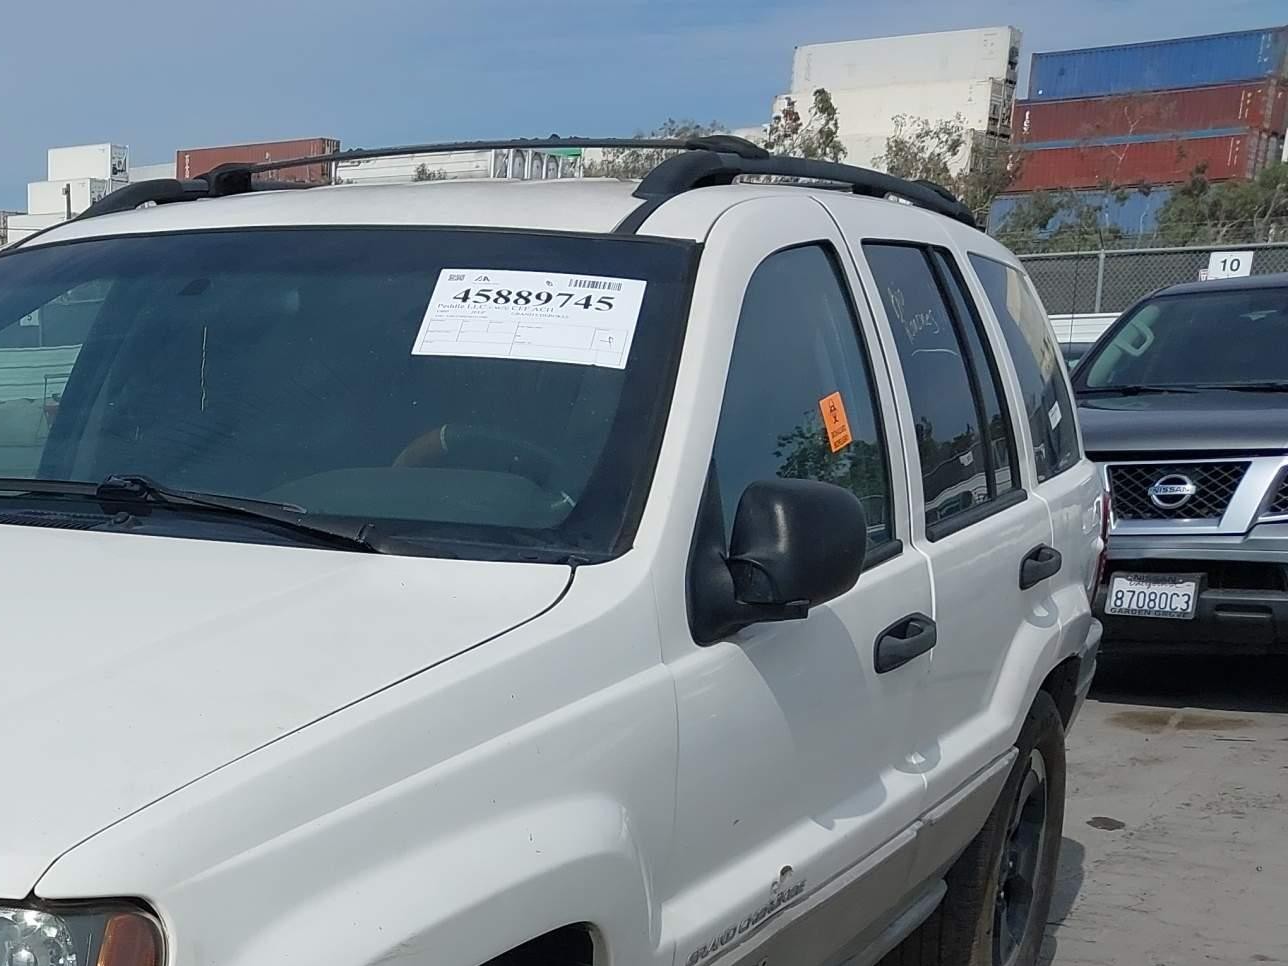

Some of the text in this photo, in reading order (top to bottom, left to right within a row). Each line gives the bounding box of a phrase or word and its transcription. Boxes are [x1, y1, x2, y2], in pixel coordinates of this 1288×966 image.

[1220, 258, 1241, 272] 10
[452, 288, 615, 312] 45889745
[1114, 590, 1191, 611] 87080C3
[1110, 607, 1151, 616] GARDEN
